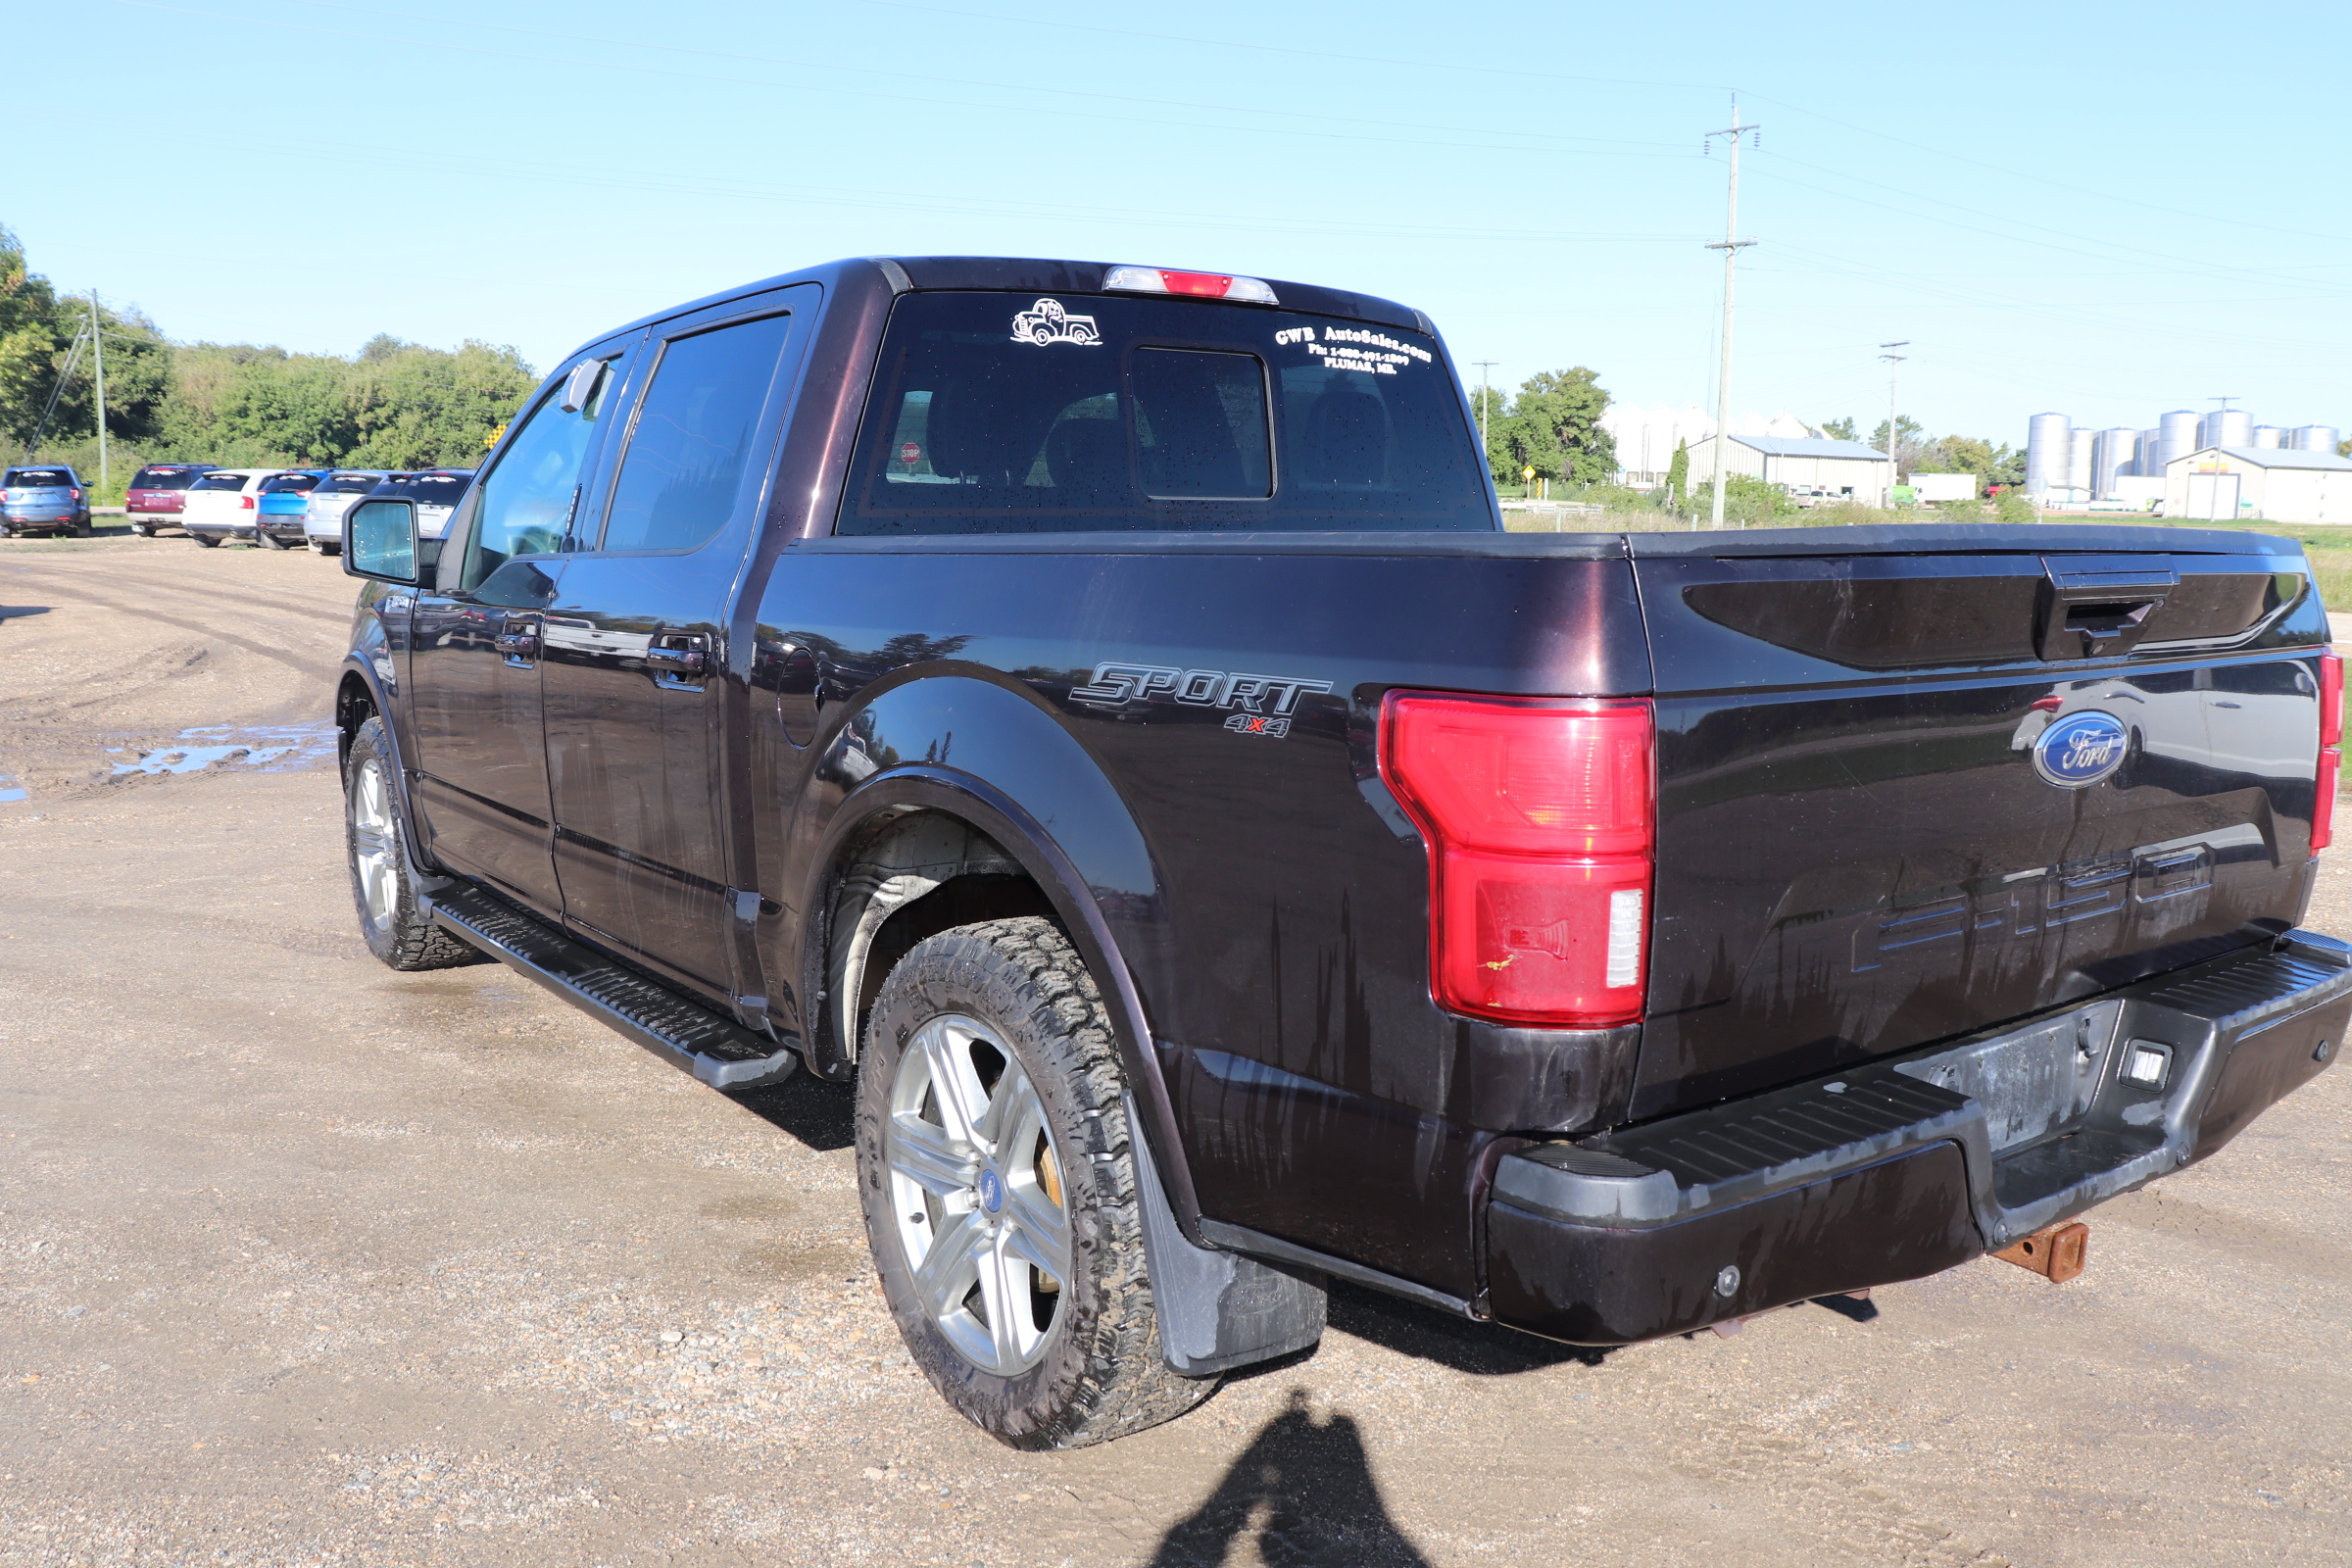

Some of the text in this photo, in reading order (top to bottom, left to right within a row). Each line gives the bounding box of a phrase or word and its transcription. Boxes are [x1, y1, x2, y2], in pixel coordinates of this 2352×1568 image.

[1275, 325, 1432, 363] GWB AutoSales.com
[1324, 357, 1375, 374] PLUMAS,
[902, 449, 919, 458] STOP
[1068, 662, 1334, 715] SPORT
[2062, 729, 2114, 770] Ford
